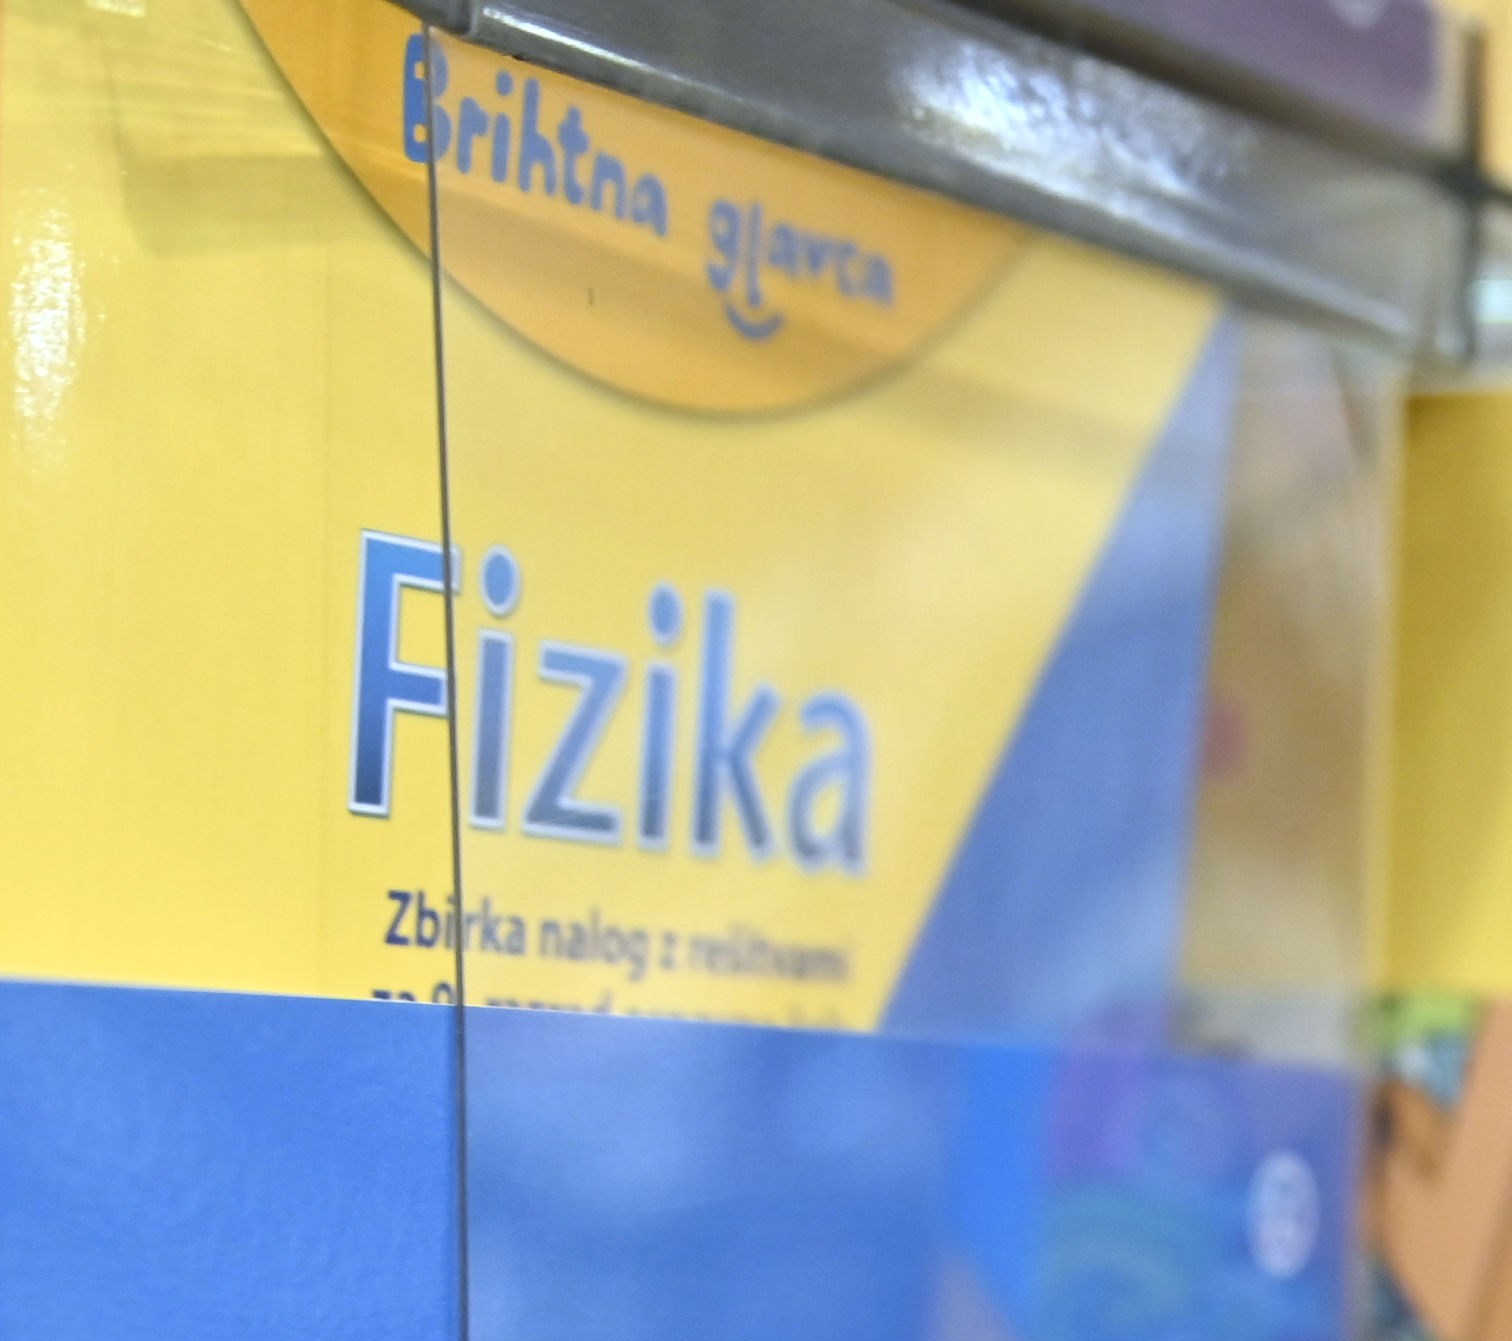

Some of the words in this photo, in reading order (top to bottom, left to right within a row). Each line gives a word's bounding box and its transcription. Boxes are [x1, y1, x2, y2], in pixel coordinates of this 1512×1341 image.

[402, 32, 672, 239] Brihtna
[705, 200, 896, 336] glavca
[346, 528, 876, 878] Fizika
[384, 888, 528, 957] Zbirka
[538, 905, 649, 980] nalog
